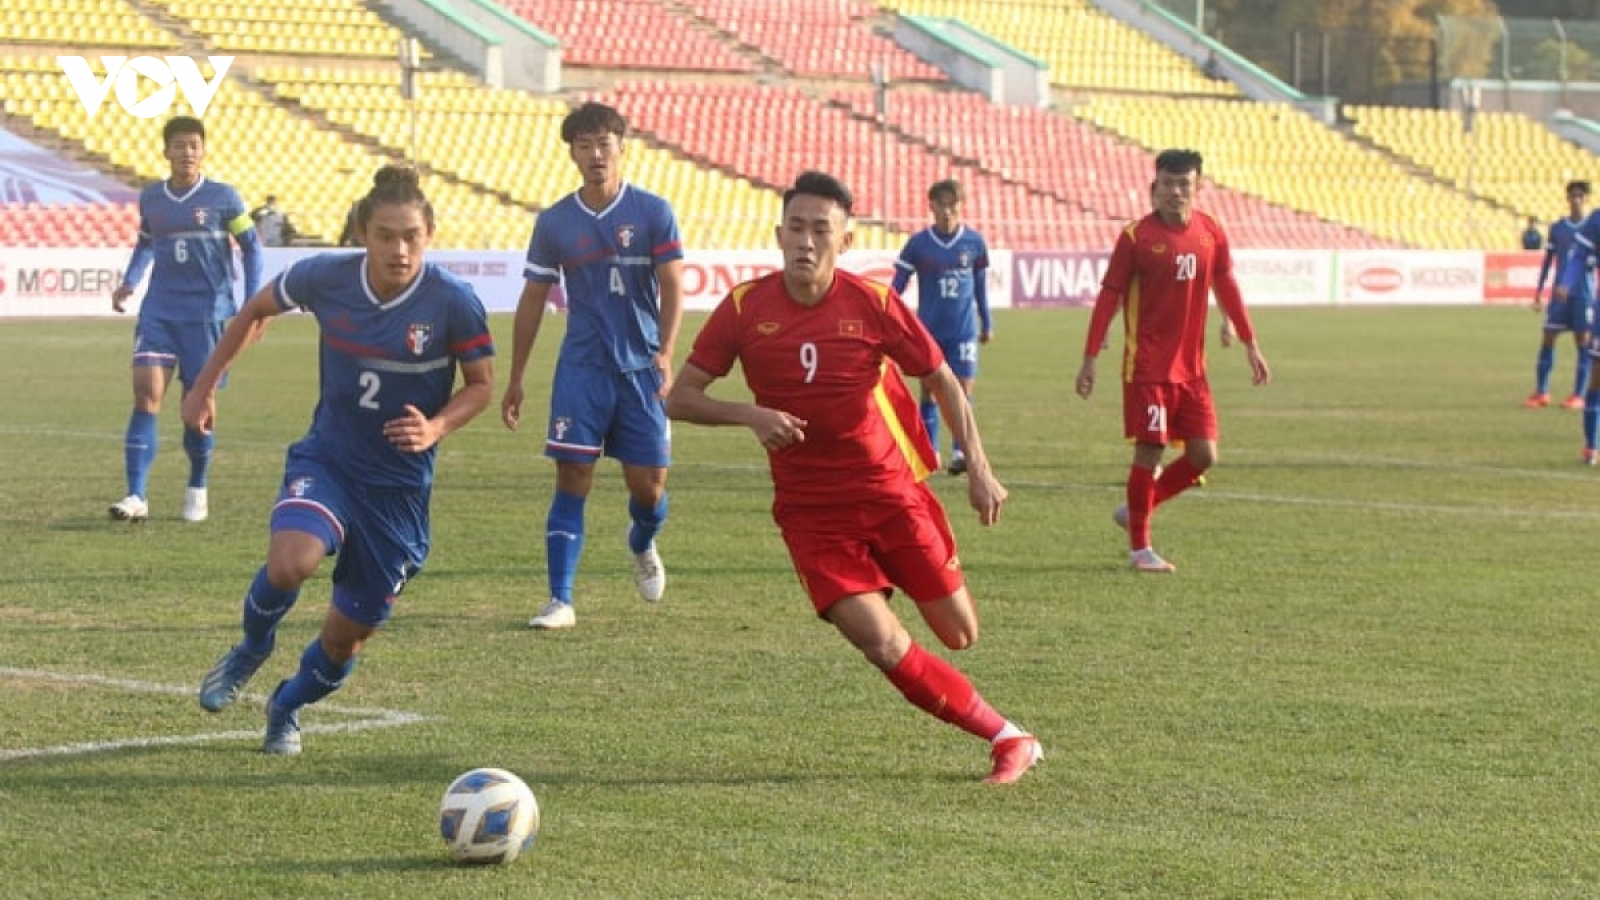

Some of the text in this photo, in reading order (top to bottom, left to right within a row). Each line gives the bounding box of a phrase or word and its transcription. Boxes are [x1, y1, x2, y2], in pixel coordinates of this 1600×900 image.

[174, 239, 188, 262] 6
[1176, 253, 1198, 281] 20
[610, 267, 626, 296] 4
[939, 278, 959, 298] 12
[800, 342, 818, 384] 9
[959, 342, 976, 361] 12
[358, 371, 381, 410] 2
